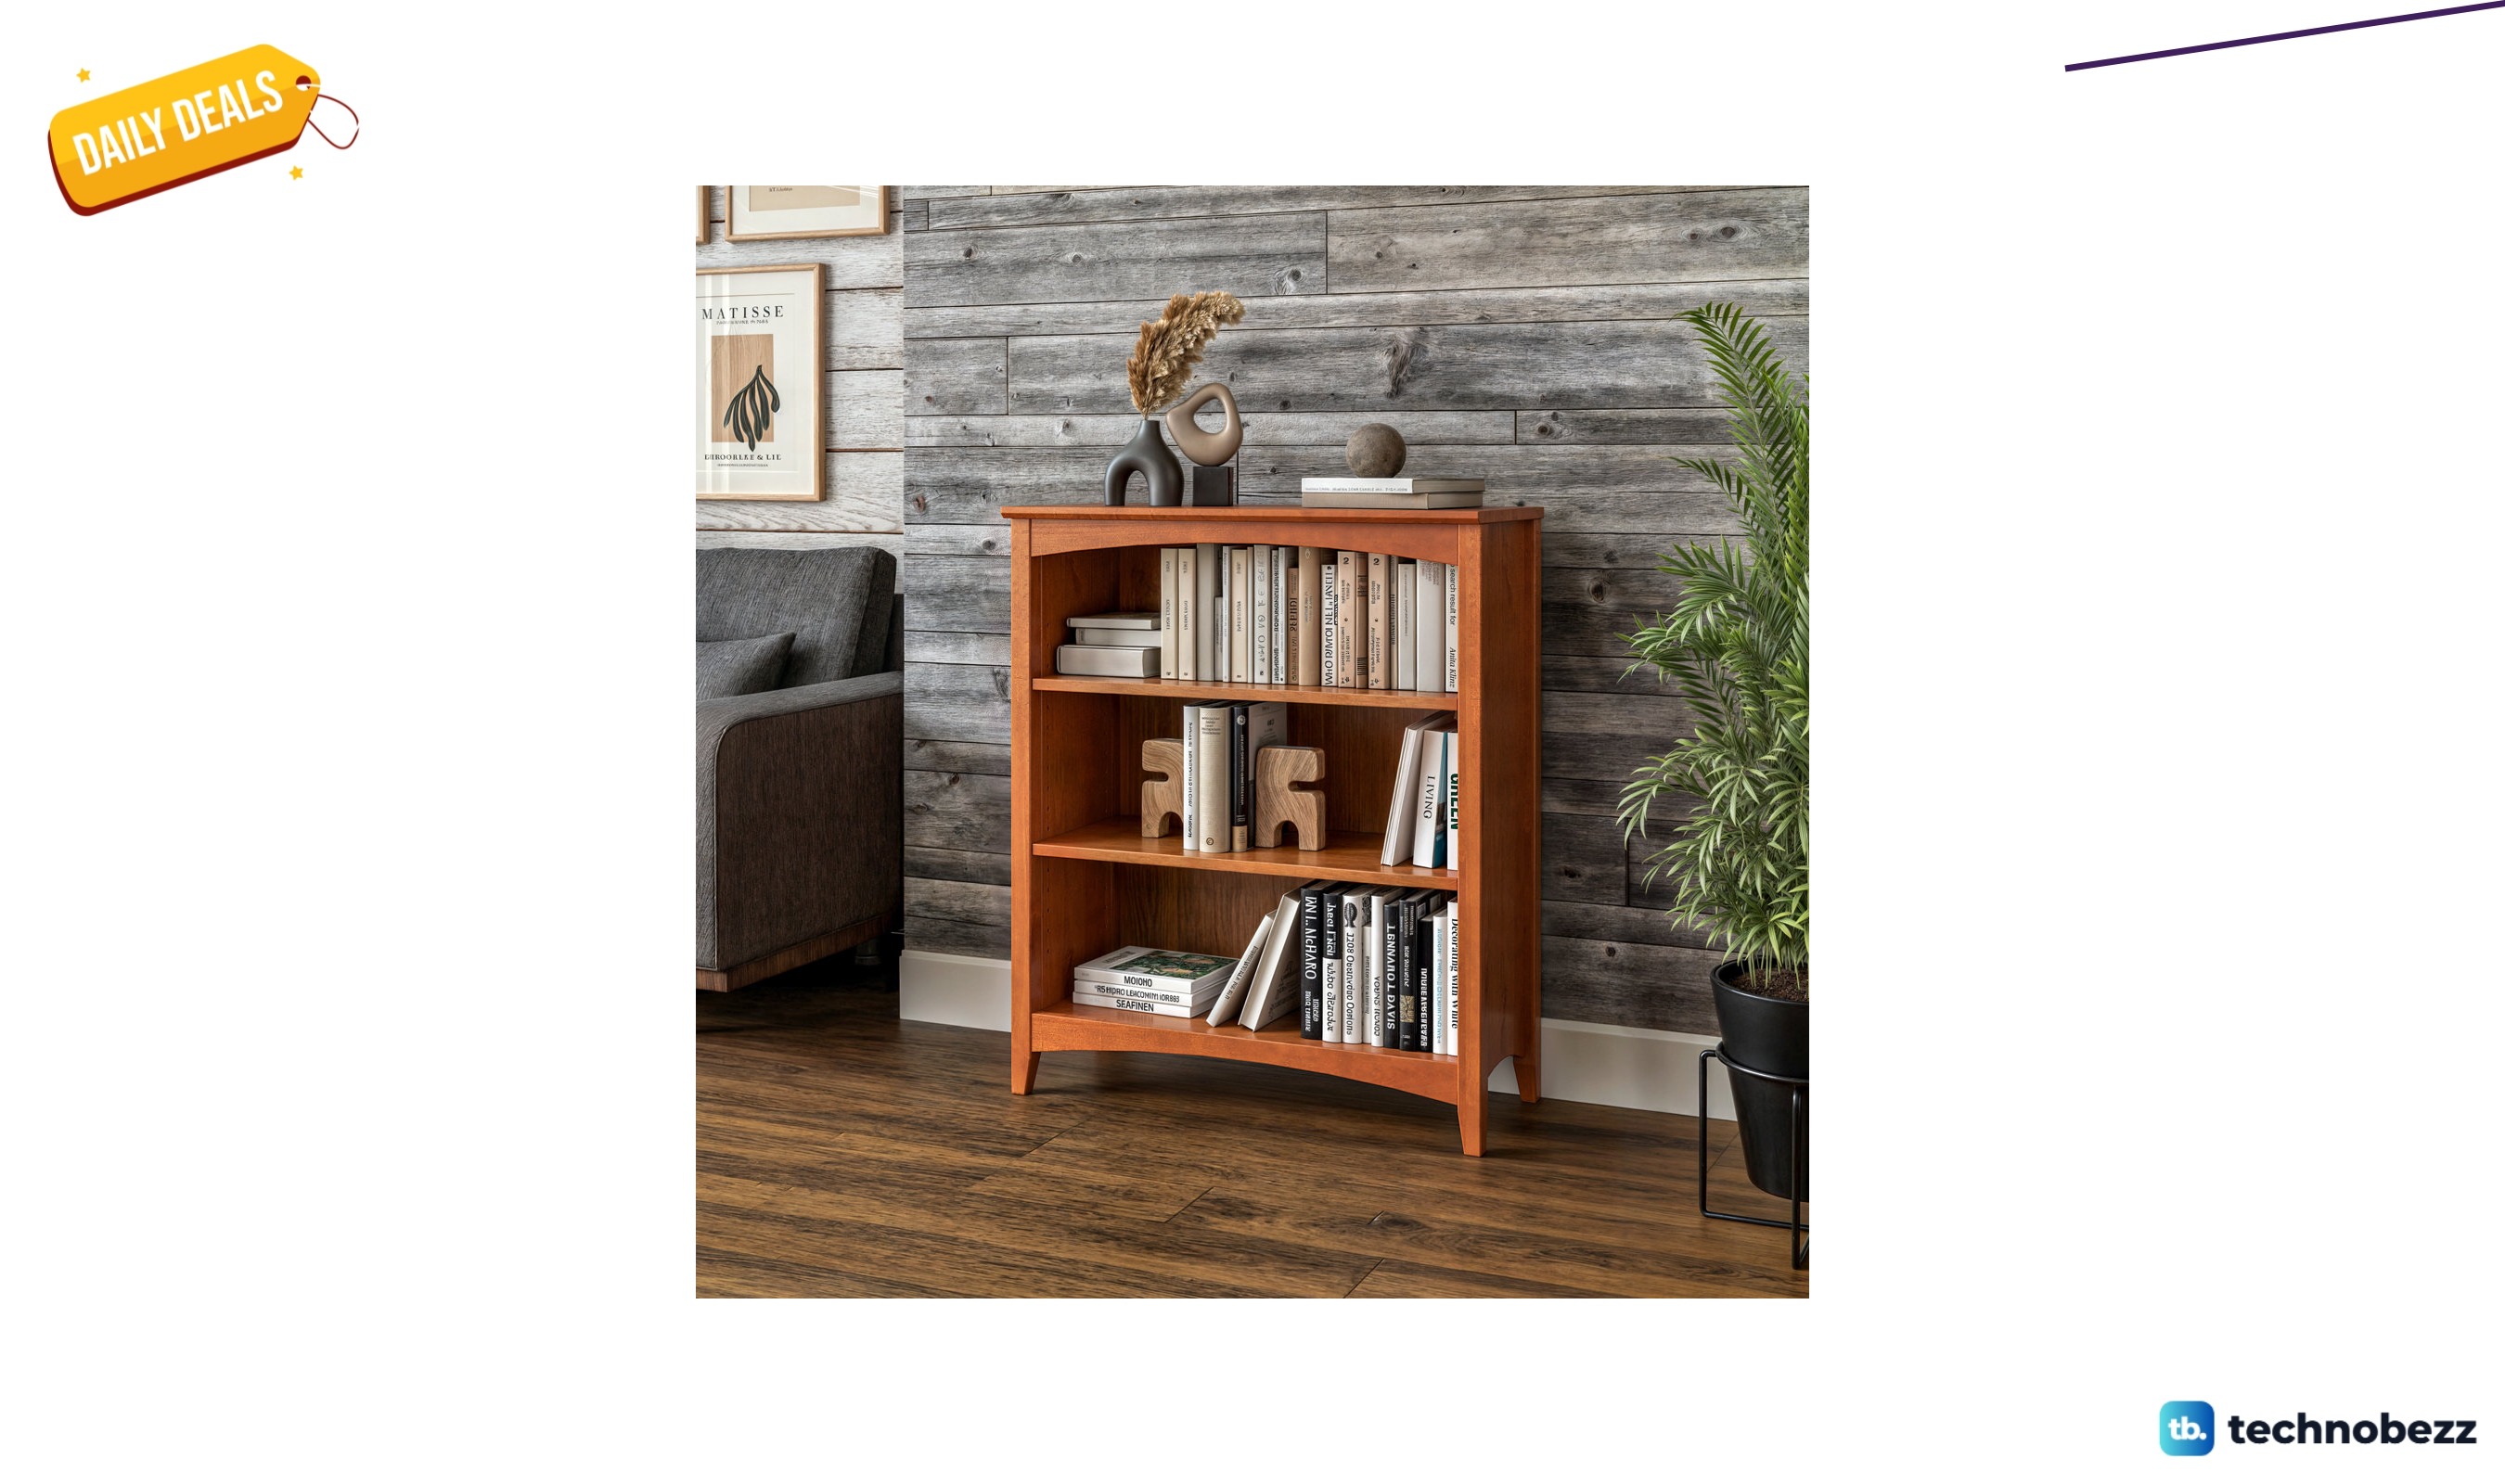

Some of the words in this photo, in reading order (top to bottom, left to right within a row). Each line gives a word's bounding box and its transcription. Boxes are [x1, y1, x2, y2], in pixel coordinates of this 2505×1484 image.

[701, 305, 783, 320] MATISSE
[1342, 556, 1350, 565] 2
[1373, 557, 1380, 566] 2
[1423, 775, 1435, 819] LIVING
[1449, 918, 1458, 972] Decorating
[1450, 973, 1458, 996] with
[1450, 998, 1458, 1030] White
